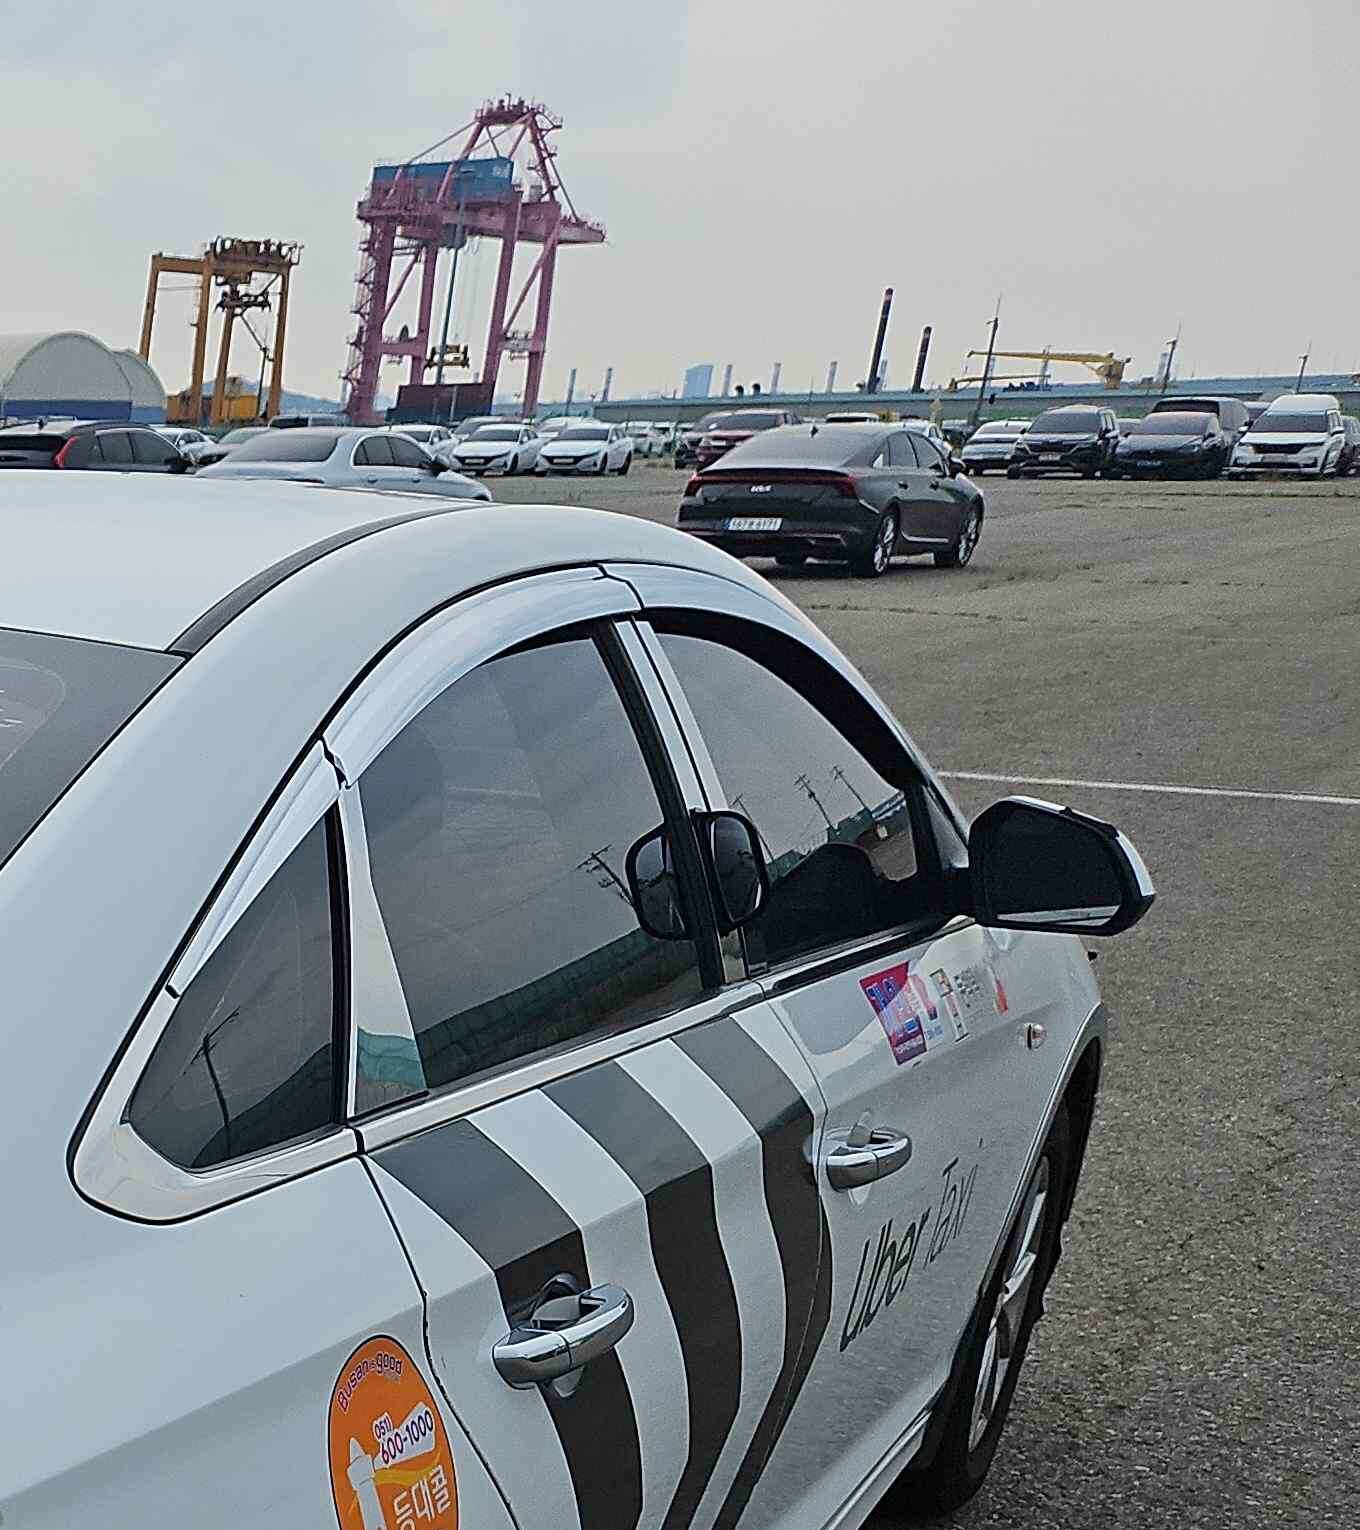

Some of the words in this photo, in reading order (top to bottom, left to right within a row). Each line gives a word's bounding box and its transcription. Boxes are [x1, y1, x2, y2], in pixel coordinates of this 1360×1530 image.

[839, 1207, 932, 1352] Uber
[337, 1359, 369, 1413] Busan
[381, 1410, 434, 1465] 600-1000
